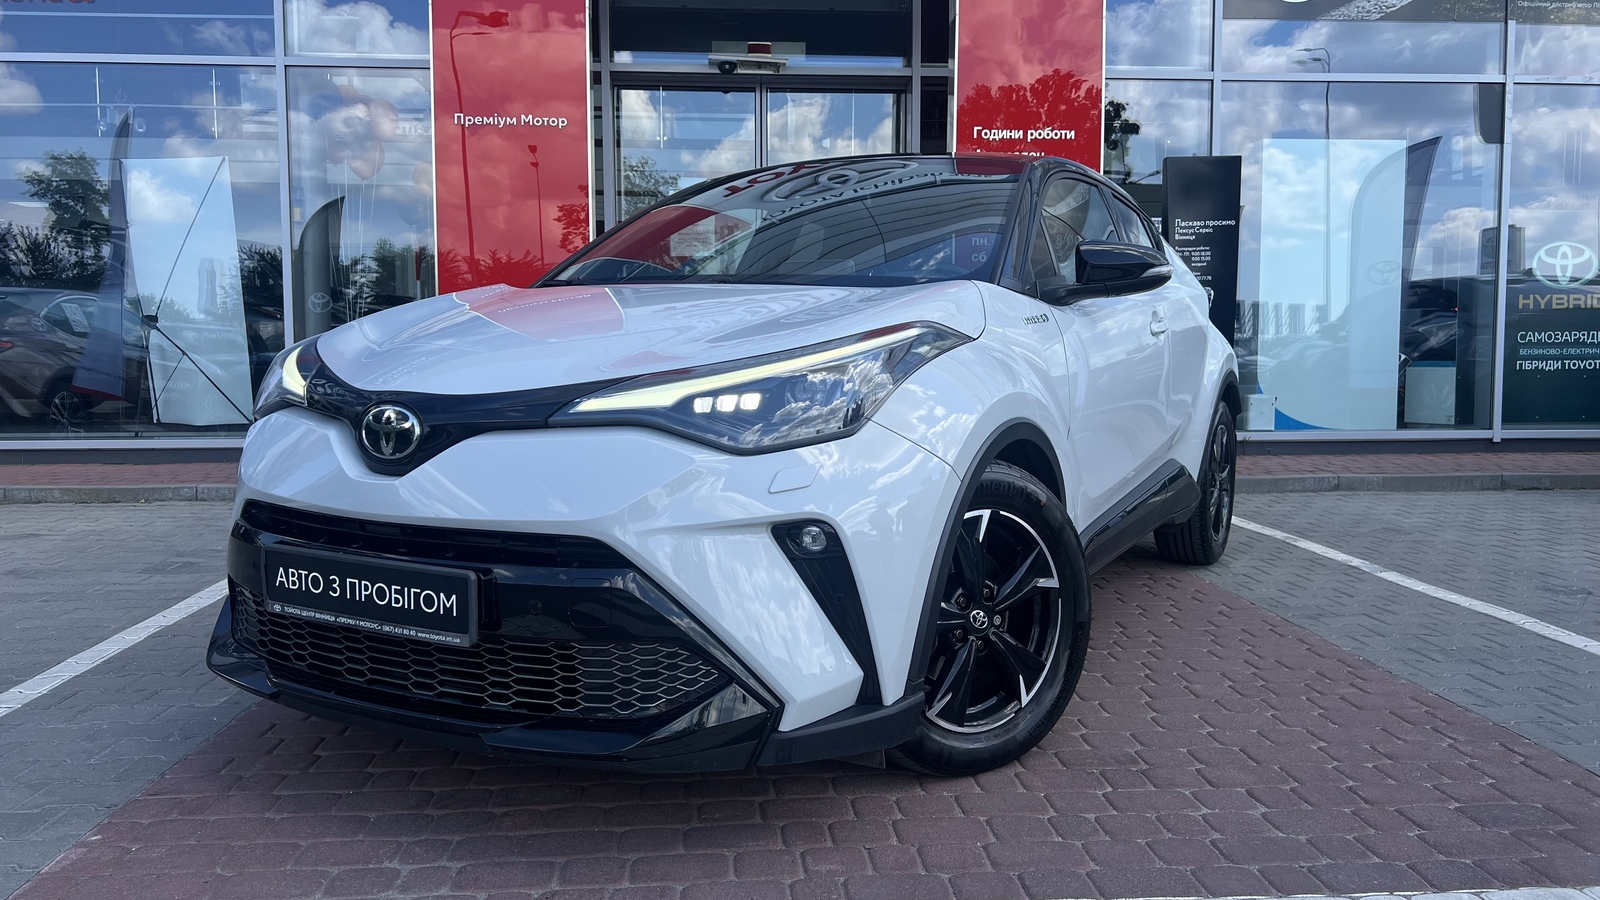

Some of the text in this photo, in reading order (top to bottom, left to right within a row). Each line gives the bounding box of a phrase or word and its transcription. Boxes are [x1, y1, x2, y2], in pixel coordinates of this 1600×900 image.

[454, 113, 568, 129] Преміум Мотор
[973, 126, 1075, 142] Години роботи
[1517, 331, 1600, 344] САМОЗАРЯД
[1516, 360, 1561, 371] ГІБРИДИ
[275, 566, 324, 594] АВТО
[346, 578, 457, 617] ПРОБІГОМ
